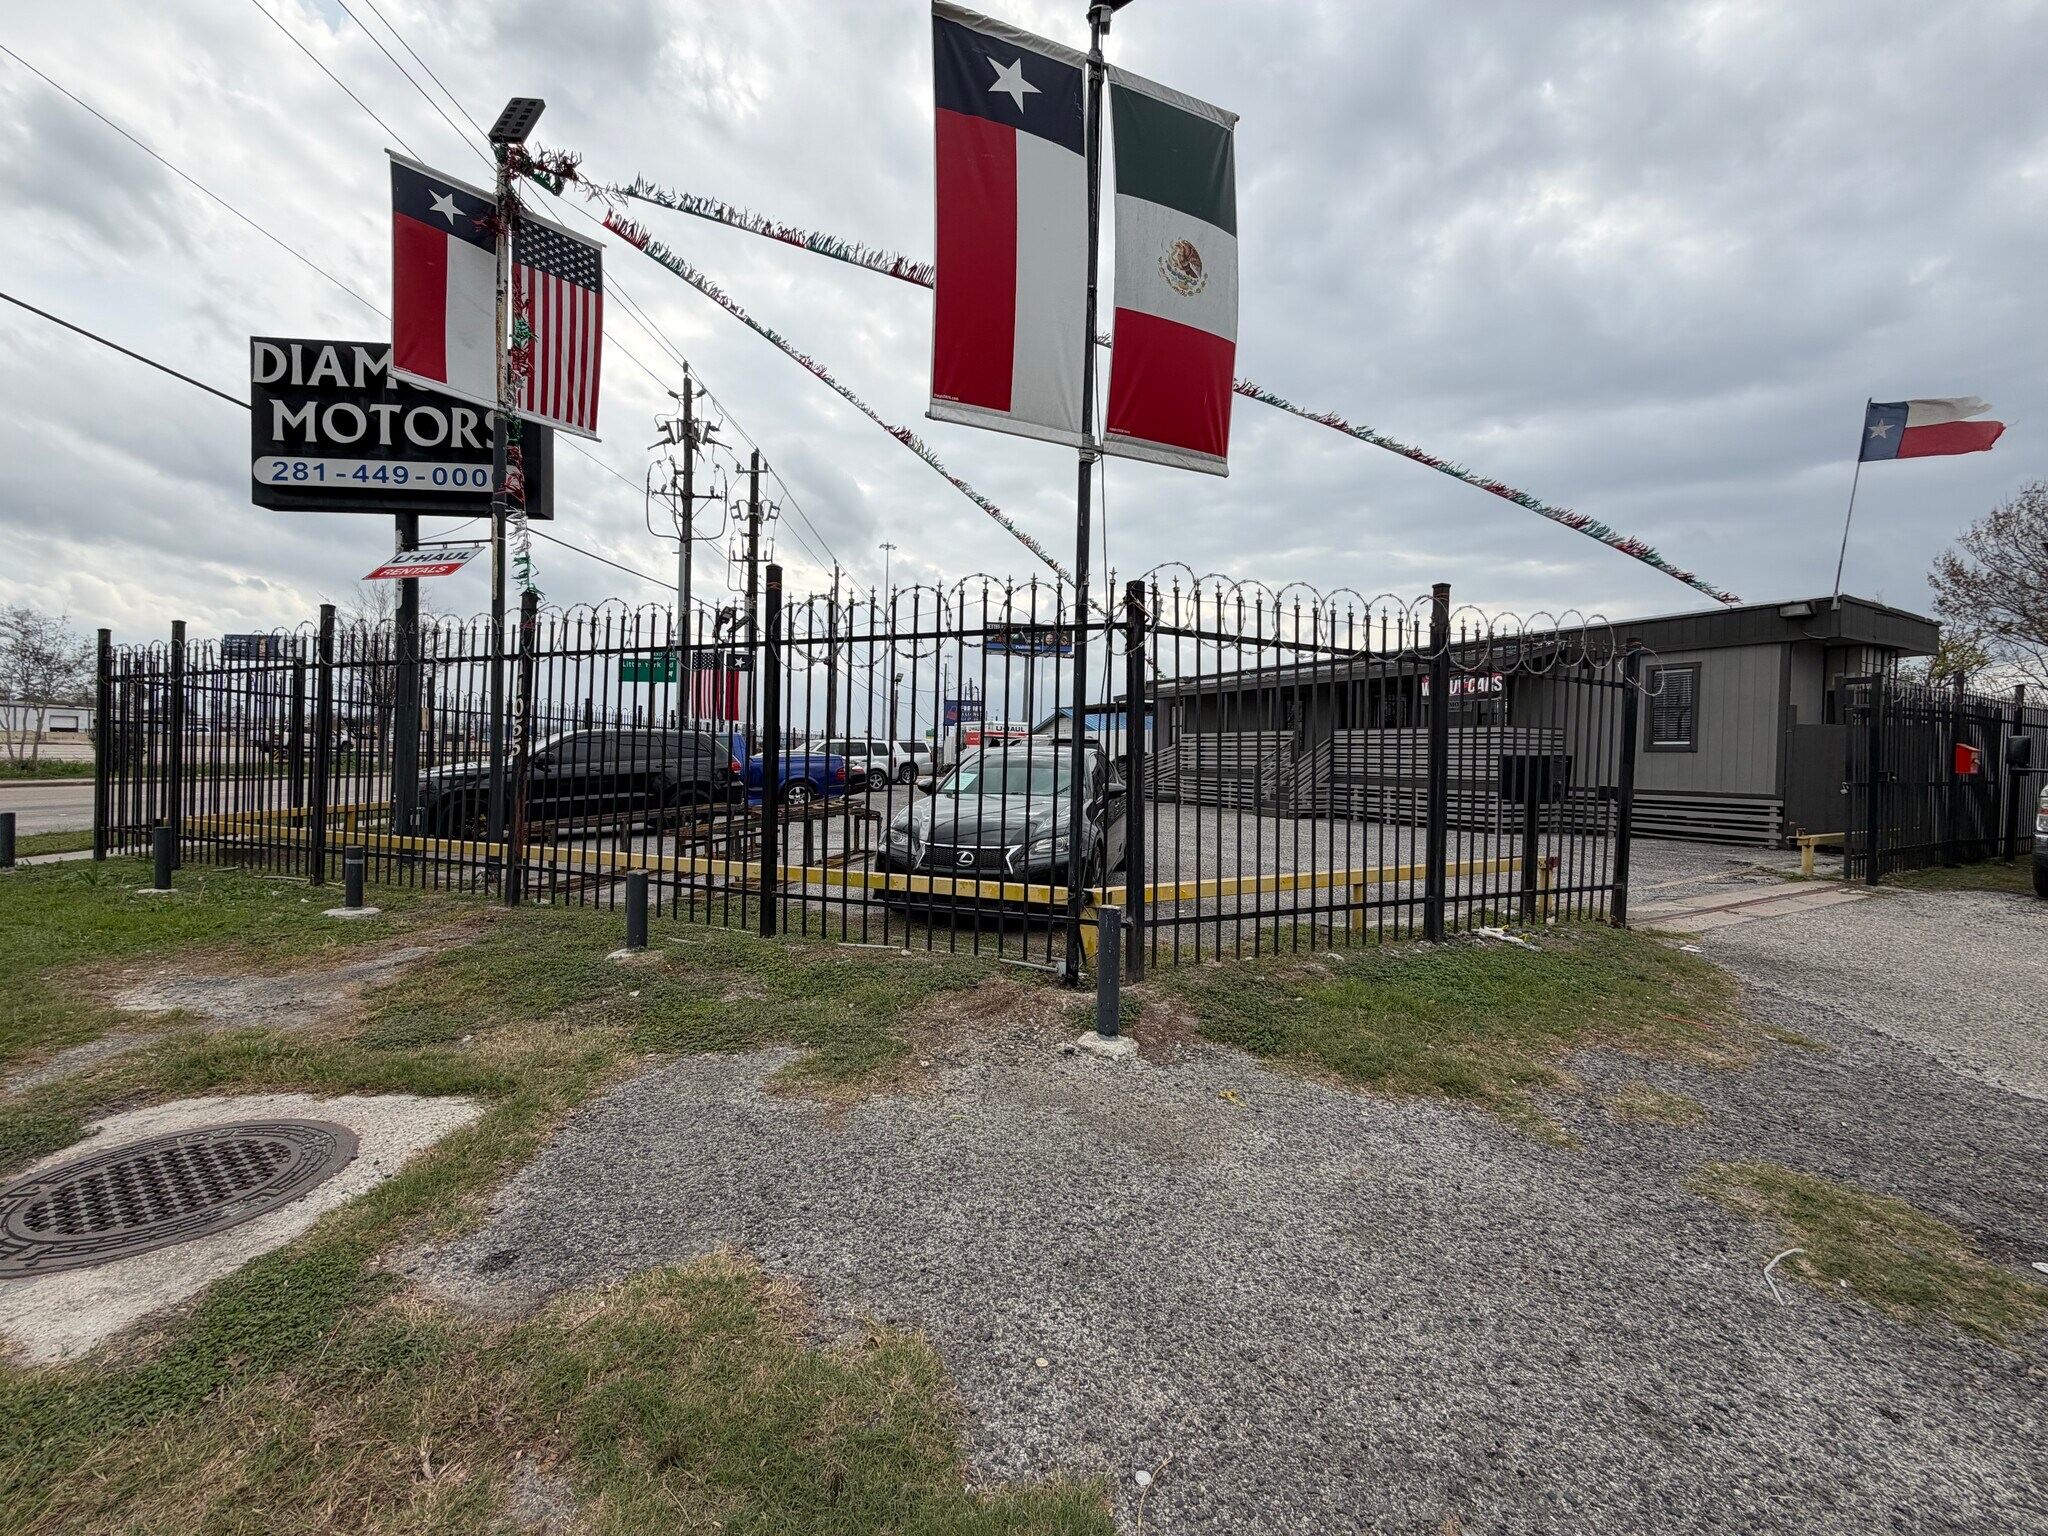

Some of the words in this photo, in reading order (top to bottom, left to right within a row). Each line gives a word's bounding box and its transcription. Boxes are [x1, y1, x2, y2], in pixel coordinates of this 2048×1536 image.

[252, 341, 432, 391] DIAM
[271, 461, 495, 487] 281-449-000
[391, 551, 470, 564] U-HAUL
[379, 565, 449, 576] RENTALS
